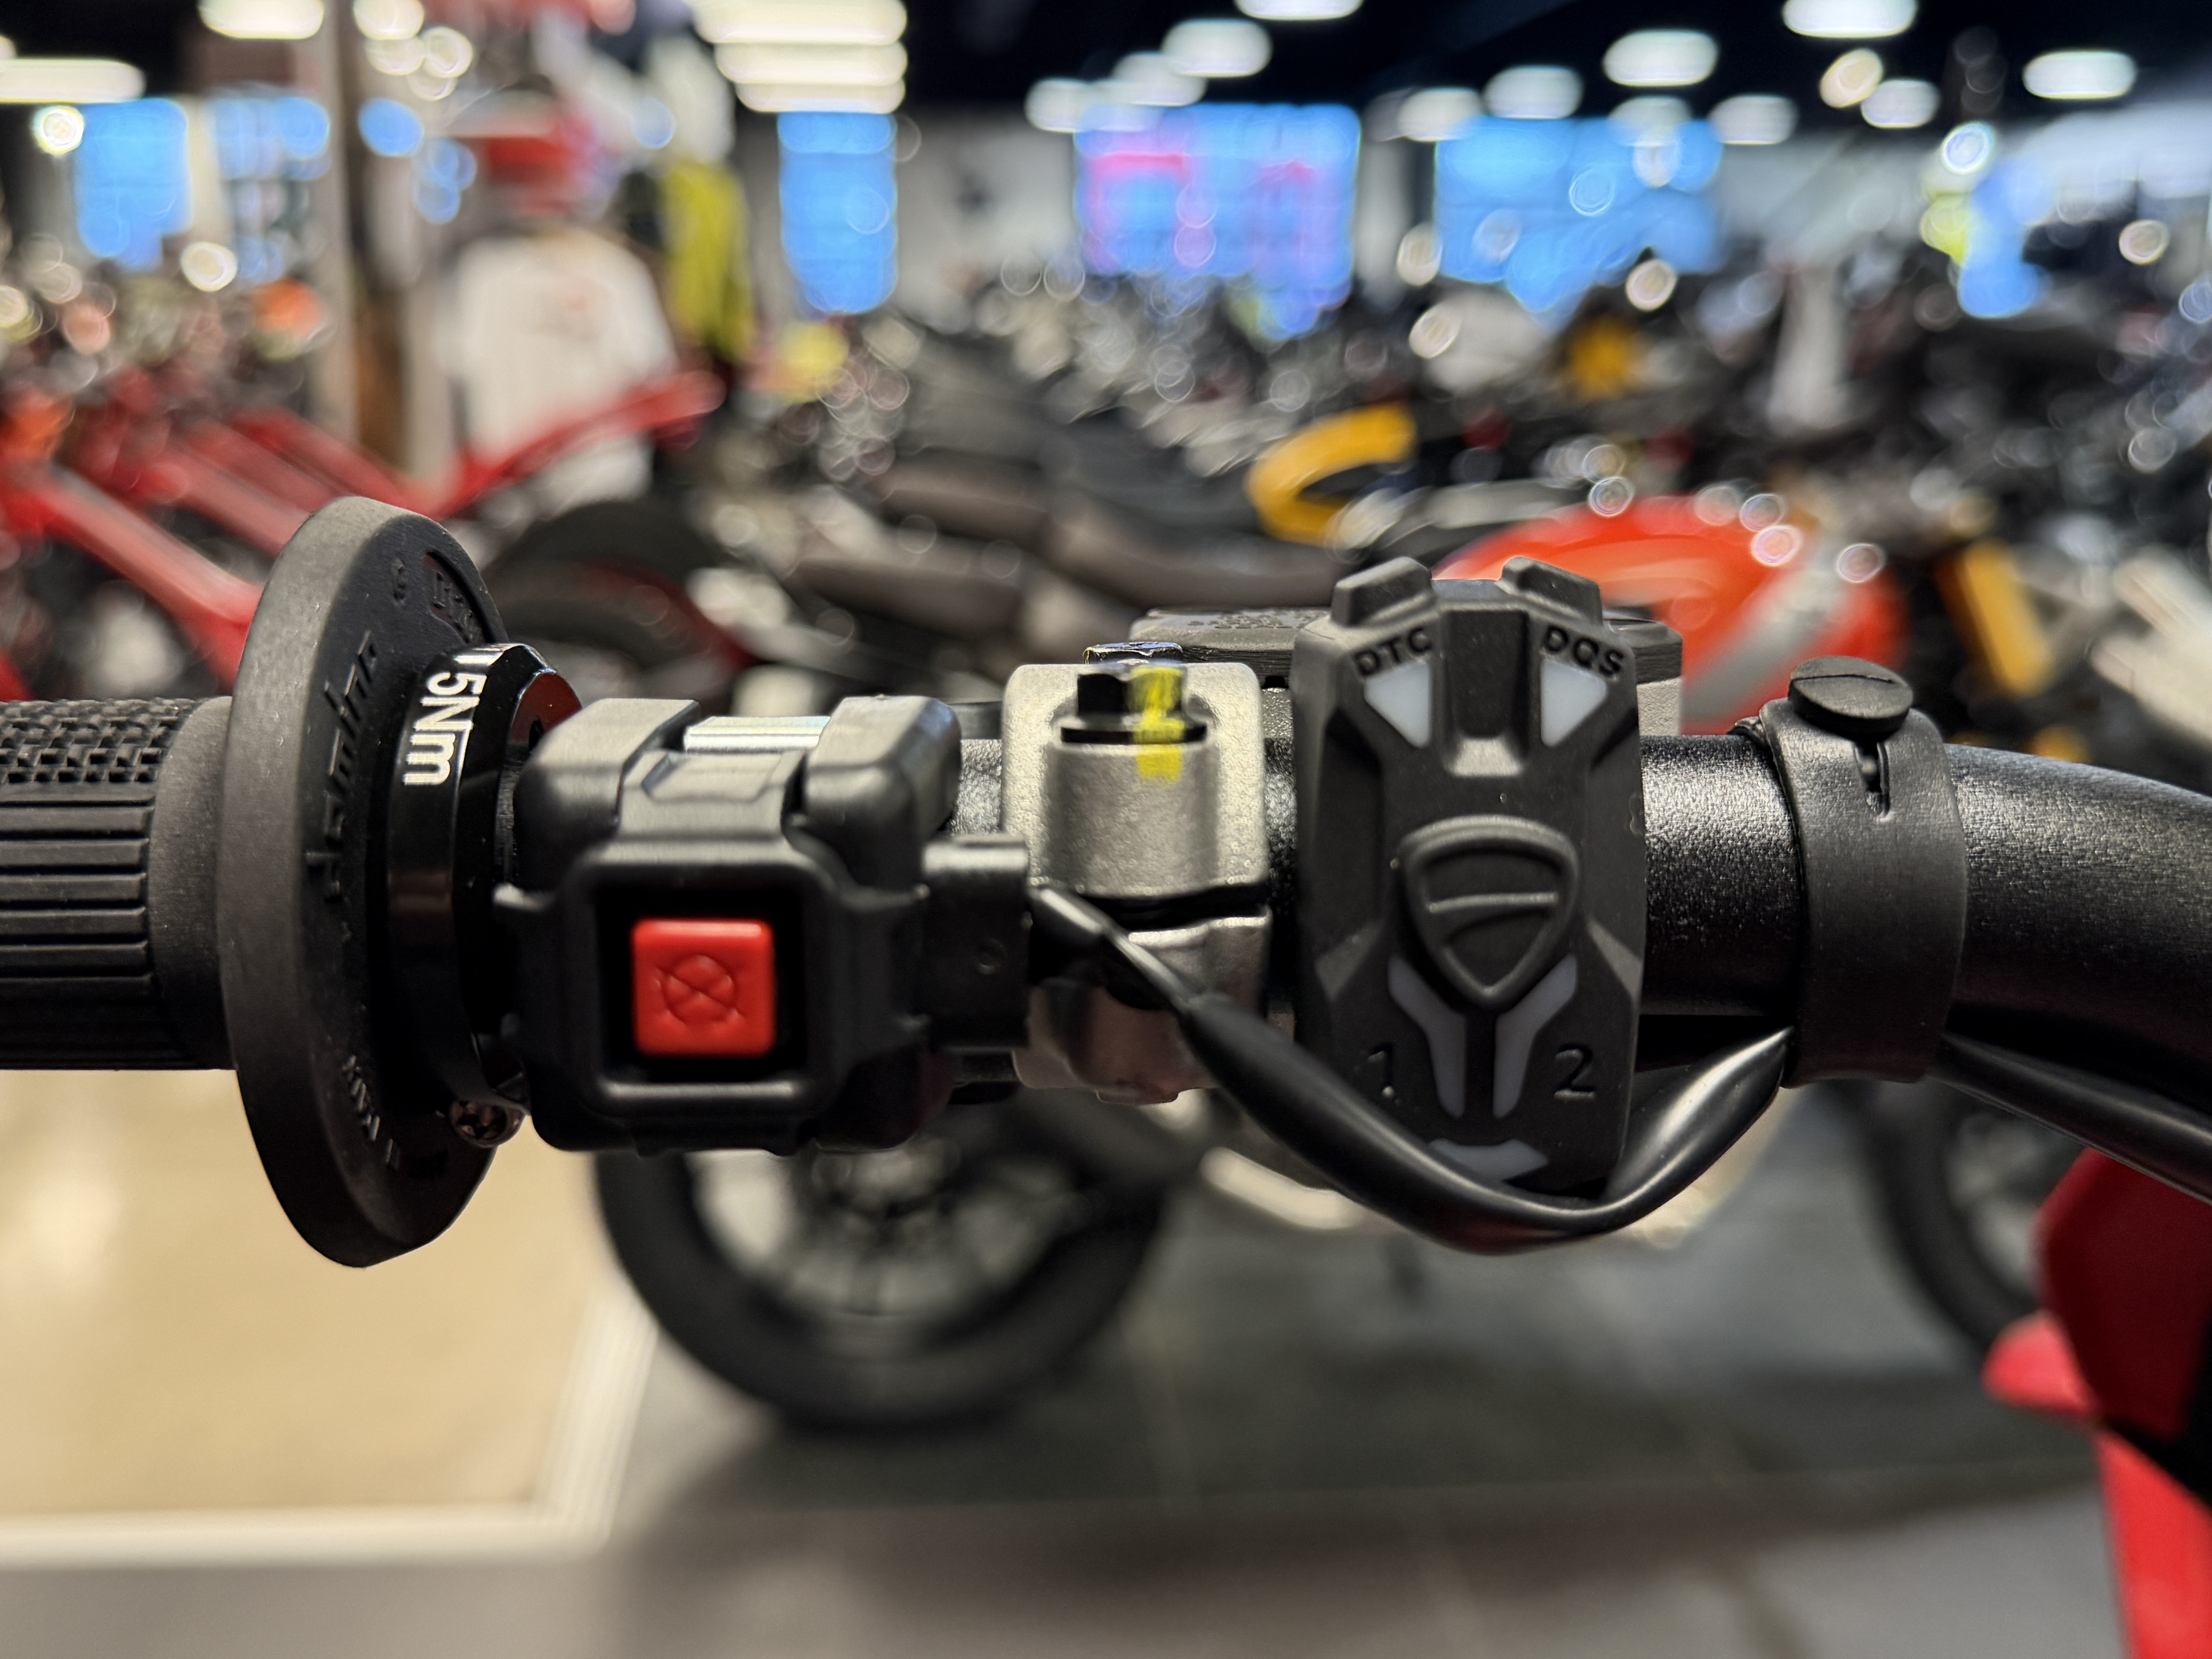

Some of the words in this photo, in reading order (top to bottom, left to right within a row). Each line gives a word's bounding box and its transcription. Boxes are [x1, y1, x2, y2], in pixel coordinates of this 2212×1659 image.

[1355, 626, 1432, 677] DTC
[1545, 625, 1624, 678] DQS
[1368, 1042, 1396, 1099] 1
[1554, 1044, 1595, 1102] 2
